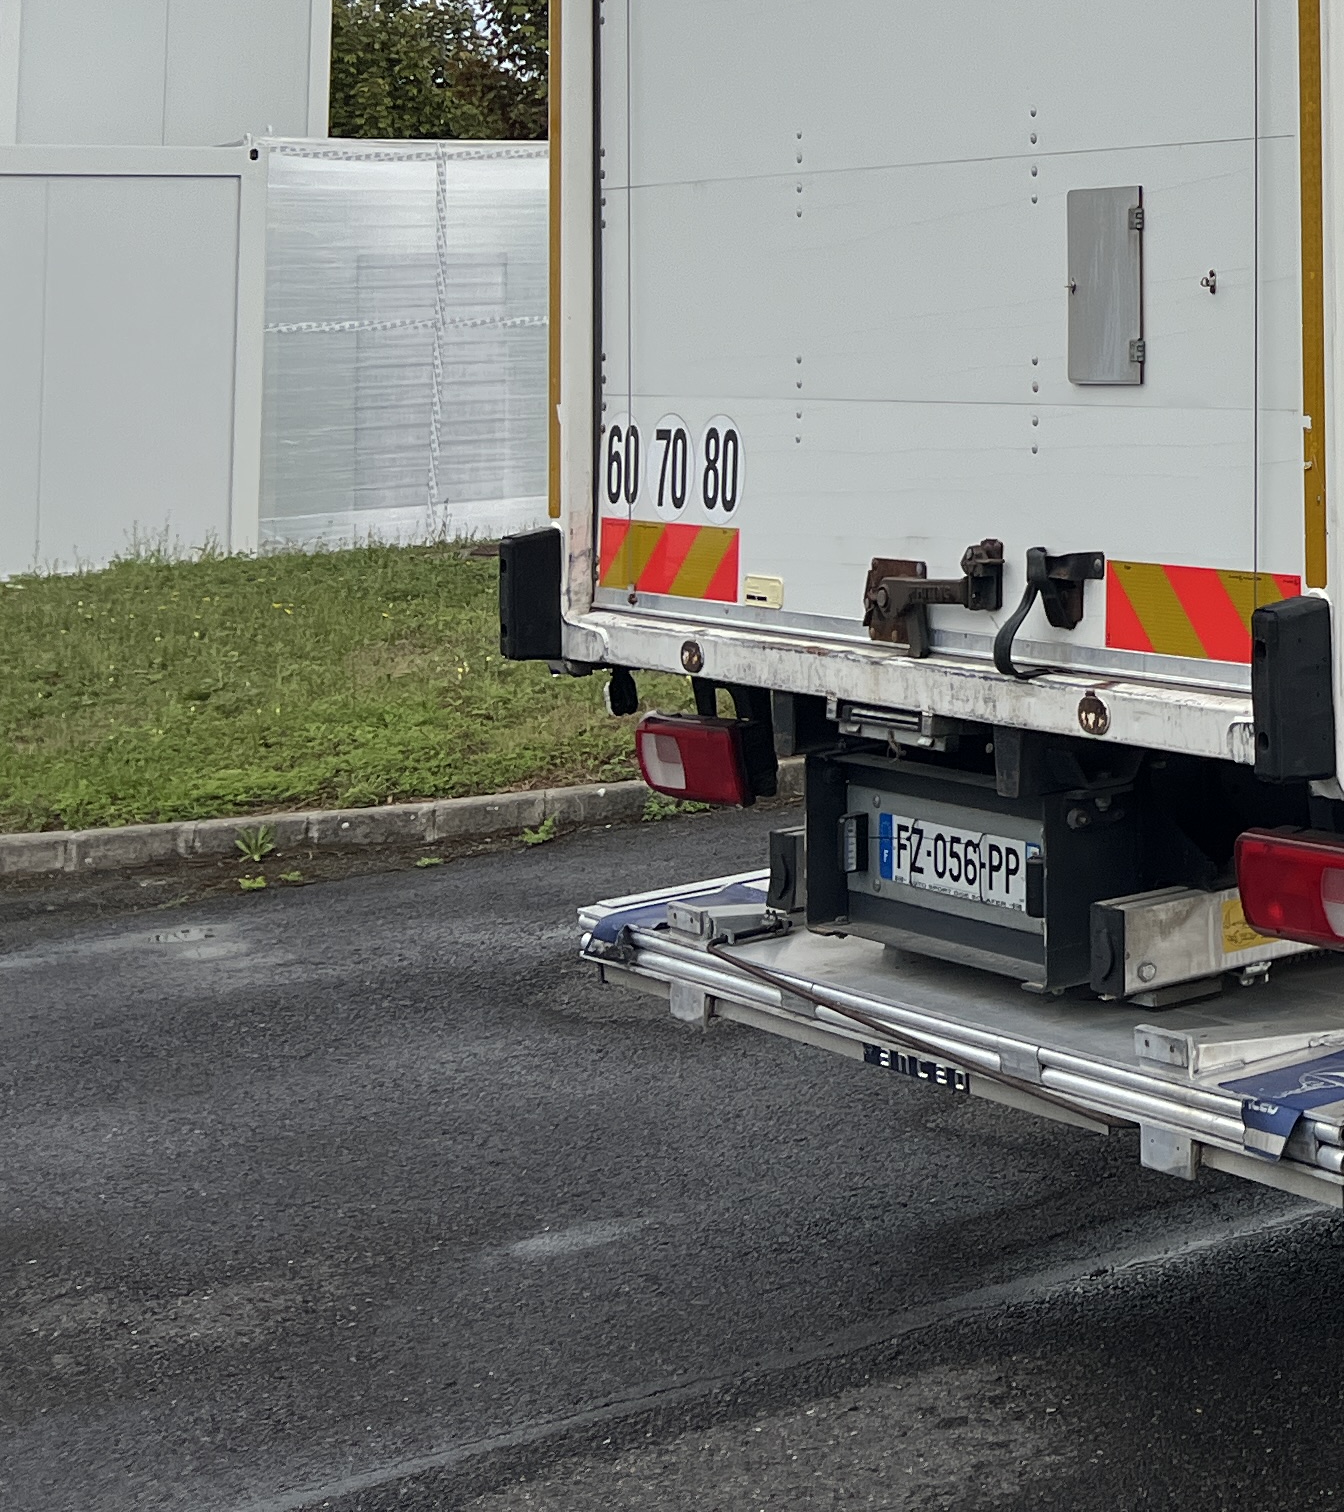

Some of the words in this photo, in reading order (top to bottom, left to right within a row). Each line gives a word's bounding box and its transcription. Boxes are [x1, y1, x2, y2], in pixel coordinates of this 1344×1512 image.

[607, 425, 640, 505] 60
[656, 428, 687, 509] 70
[702, 427, 739, 513] 80
